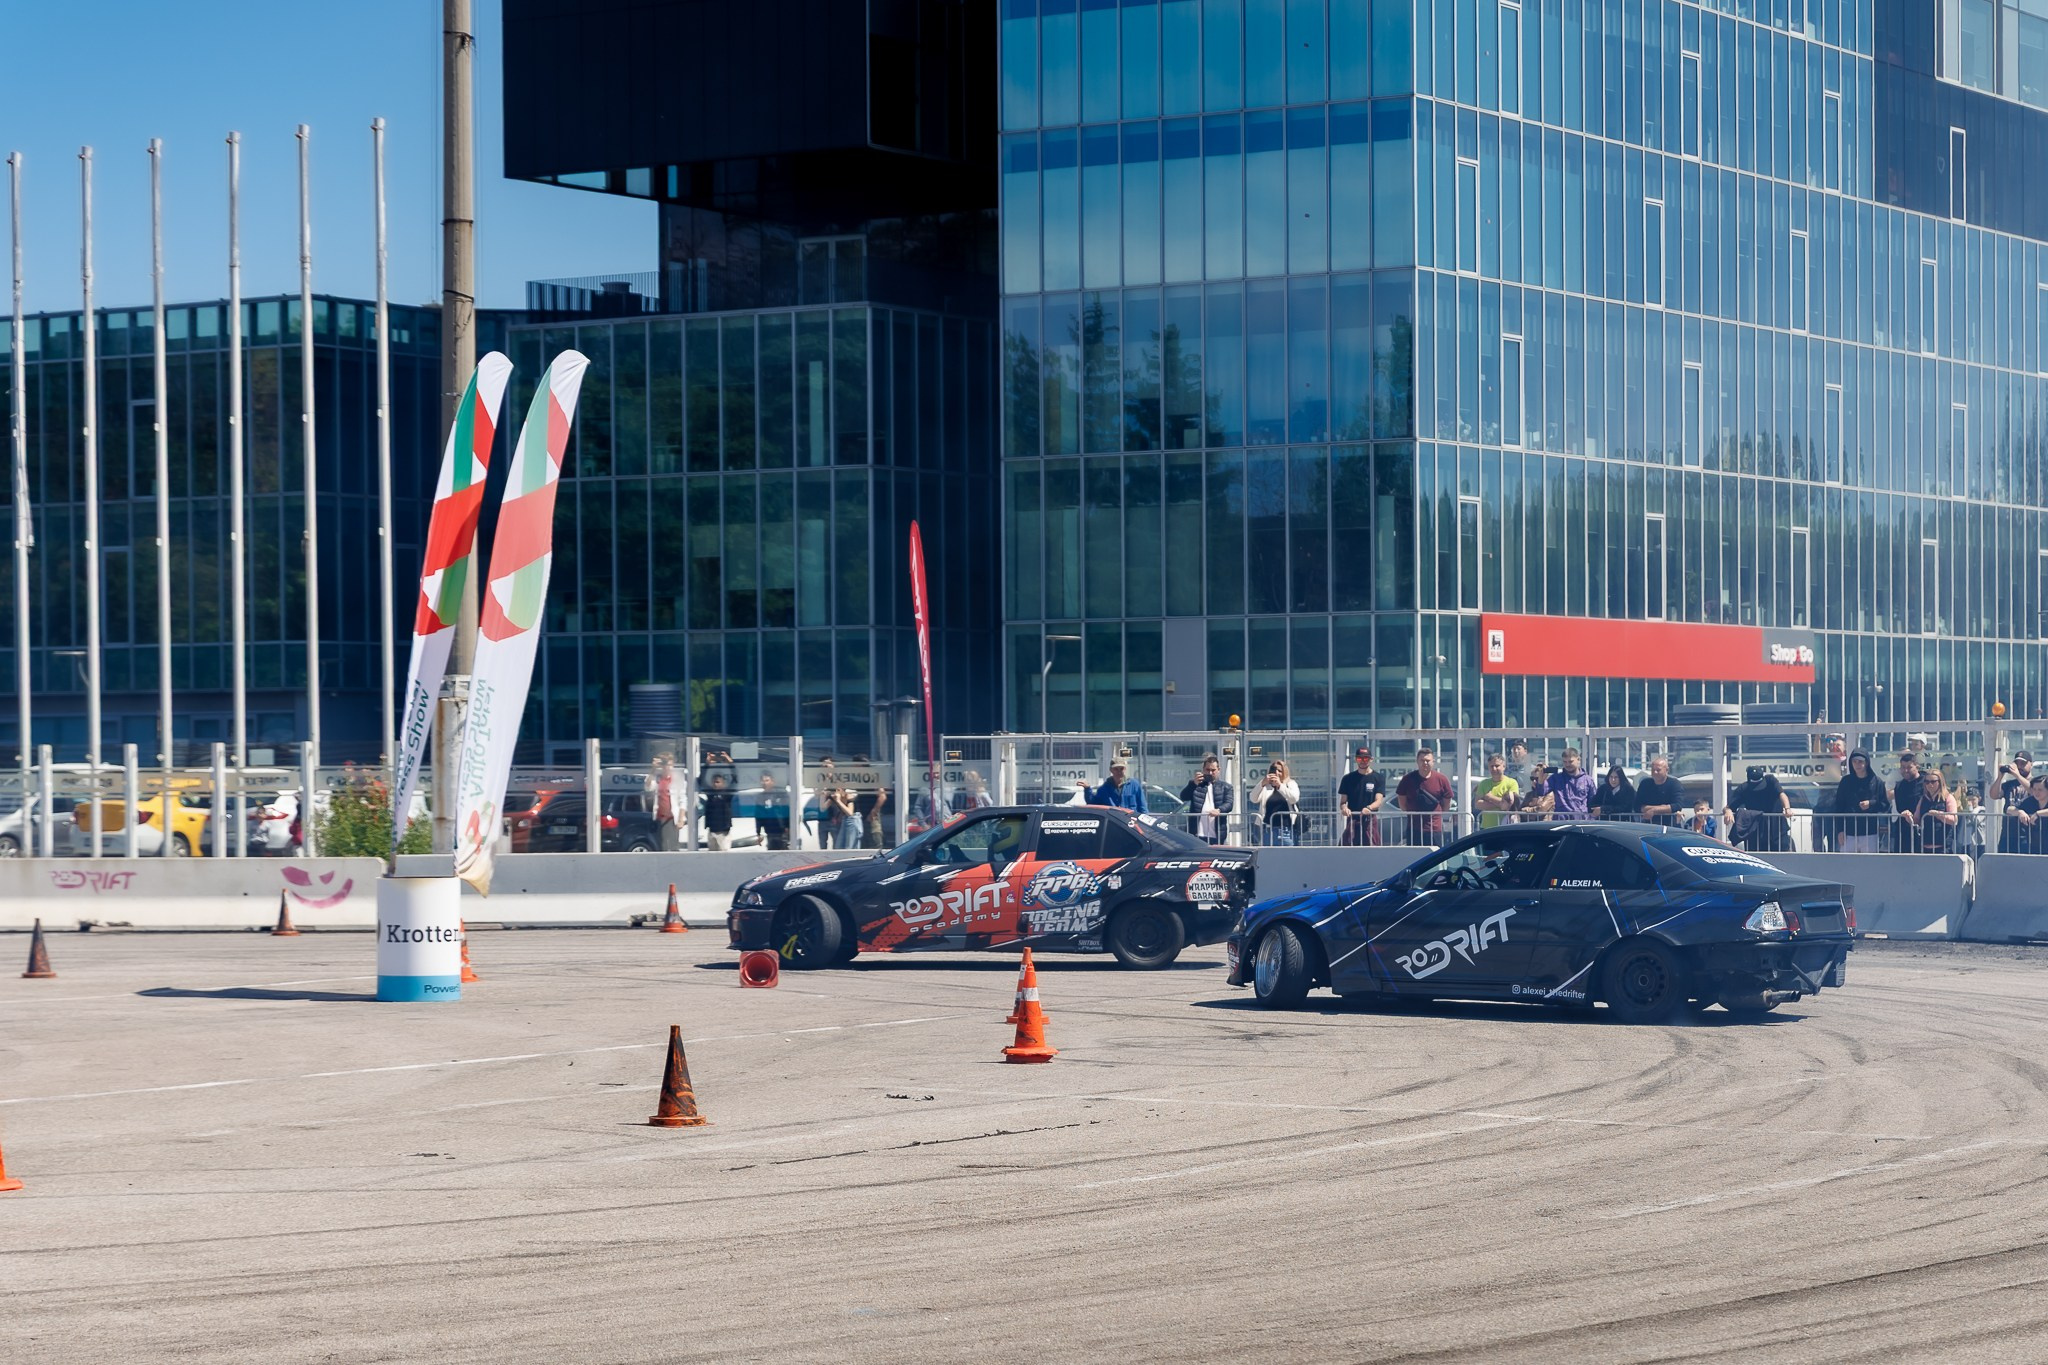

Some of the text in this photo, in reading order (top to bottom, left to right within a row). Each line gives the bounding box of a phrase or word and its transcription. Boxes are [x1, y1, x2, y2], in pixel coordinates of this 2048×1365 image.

[408, 688, 429, 751] Show
[1031, 873, 1089, 897] PPG
[1189, 883, 1229, 891] WRAPPING
[1561, 879, 1591, 887] ALEXEI
[1191, 892, 1223, 900] GARAGE
[1032, 917, 1088, 932] TEAM
